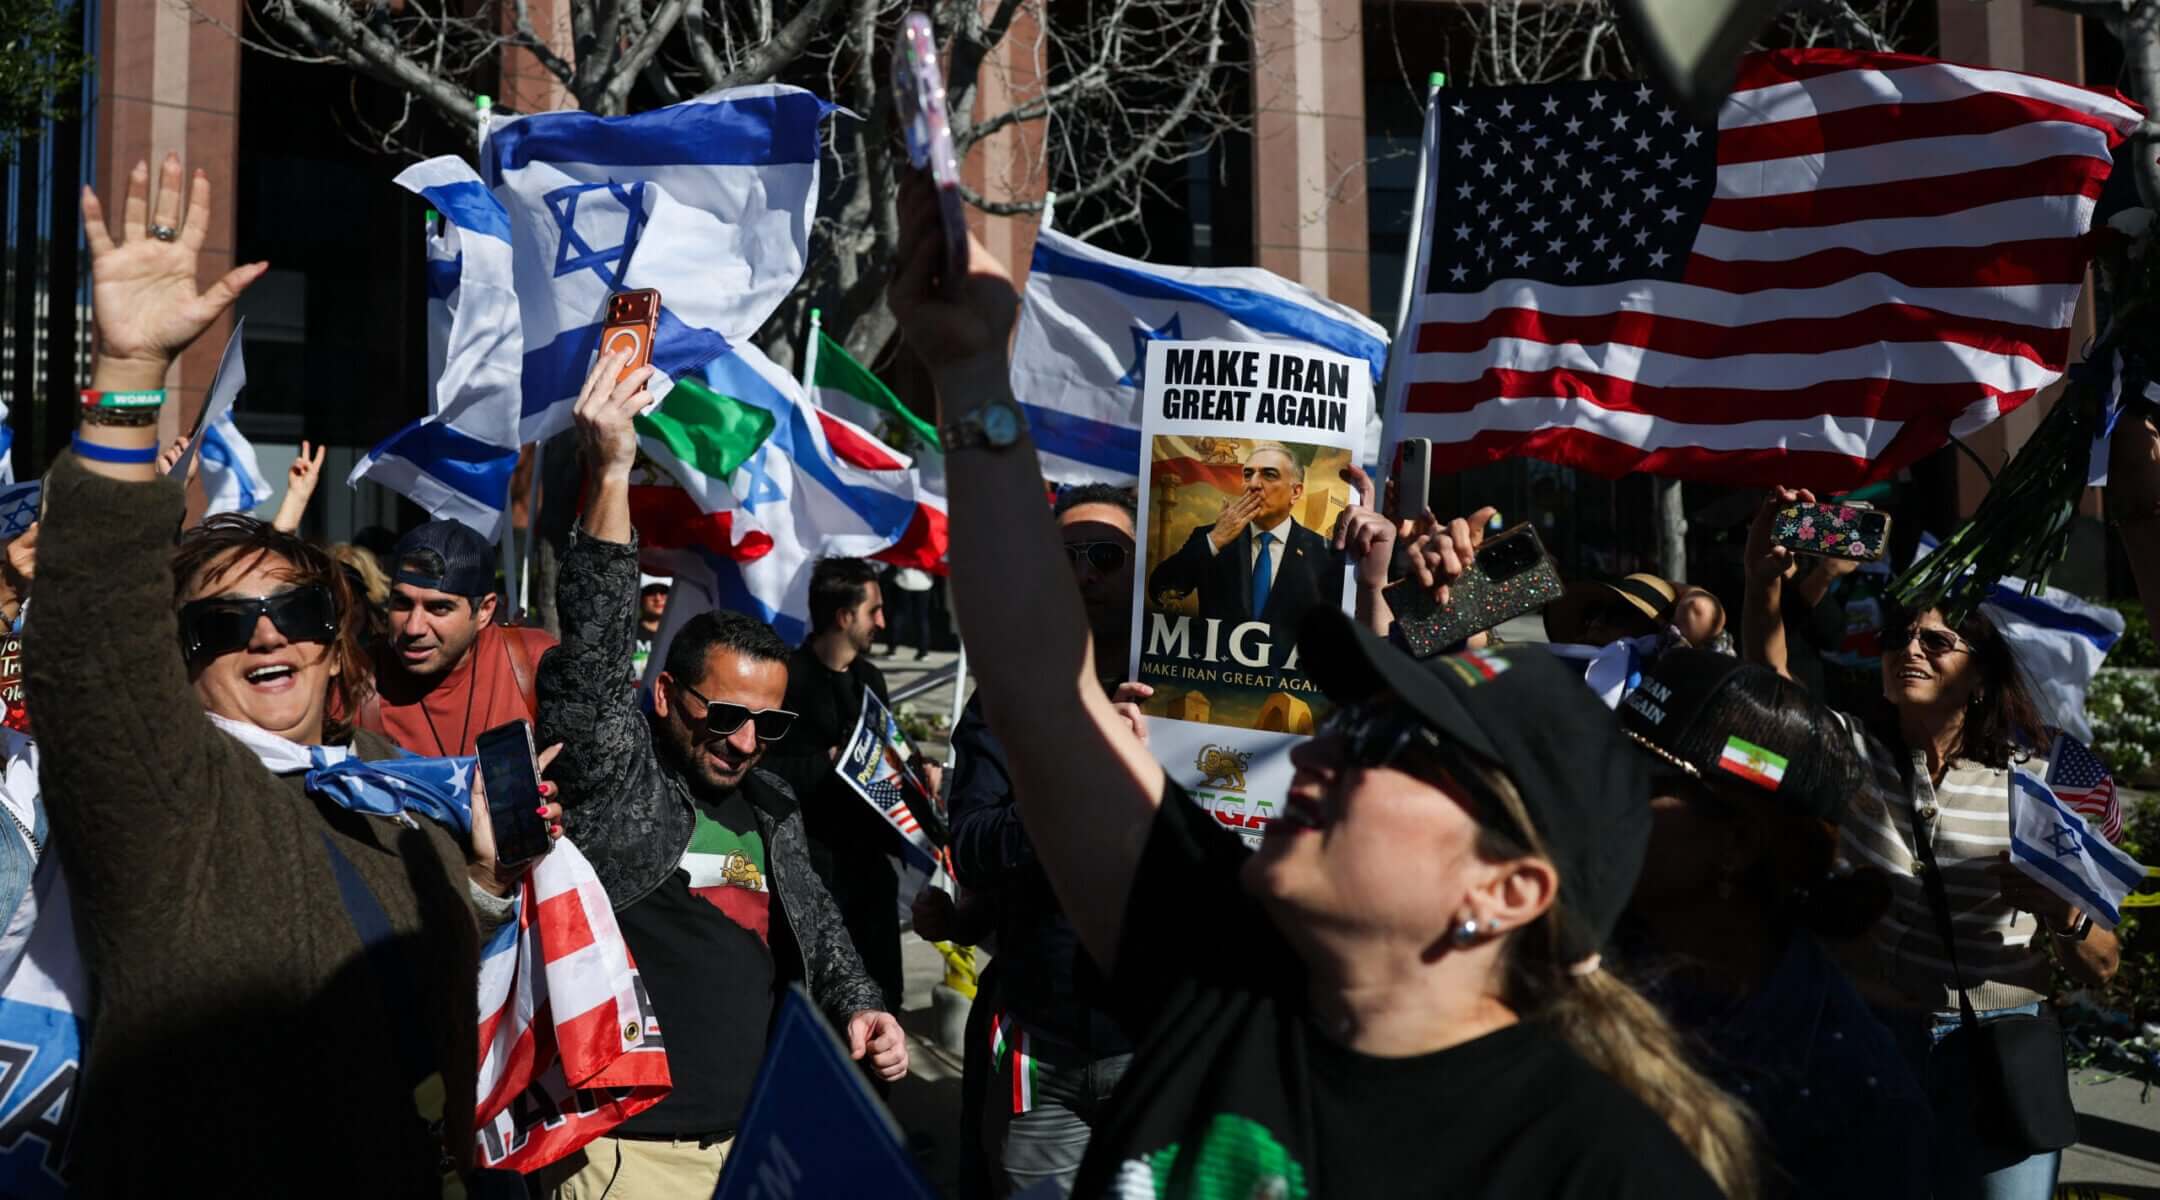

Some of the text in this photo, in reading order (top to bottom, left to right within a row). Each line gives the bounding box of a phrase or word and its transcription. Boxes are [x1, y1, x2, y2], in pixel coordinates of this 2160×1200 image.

[1164, 348, 1350, 399] MAKE IRAN
[113, 394, 161, 405] WOMAN
[1162, 388, 1347, 433] GREAT AGAIN
[1141, 661, 1323, 694] MAKE IRAN GREAT AGAI
[1184, 789, 1275, 830] IGA
